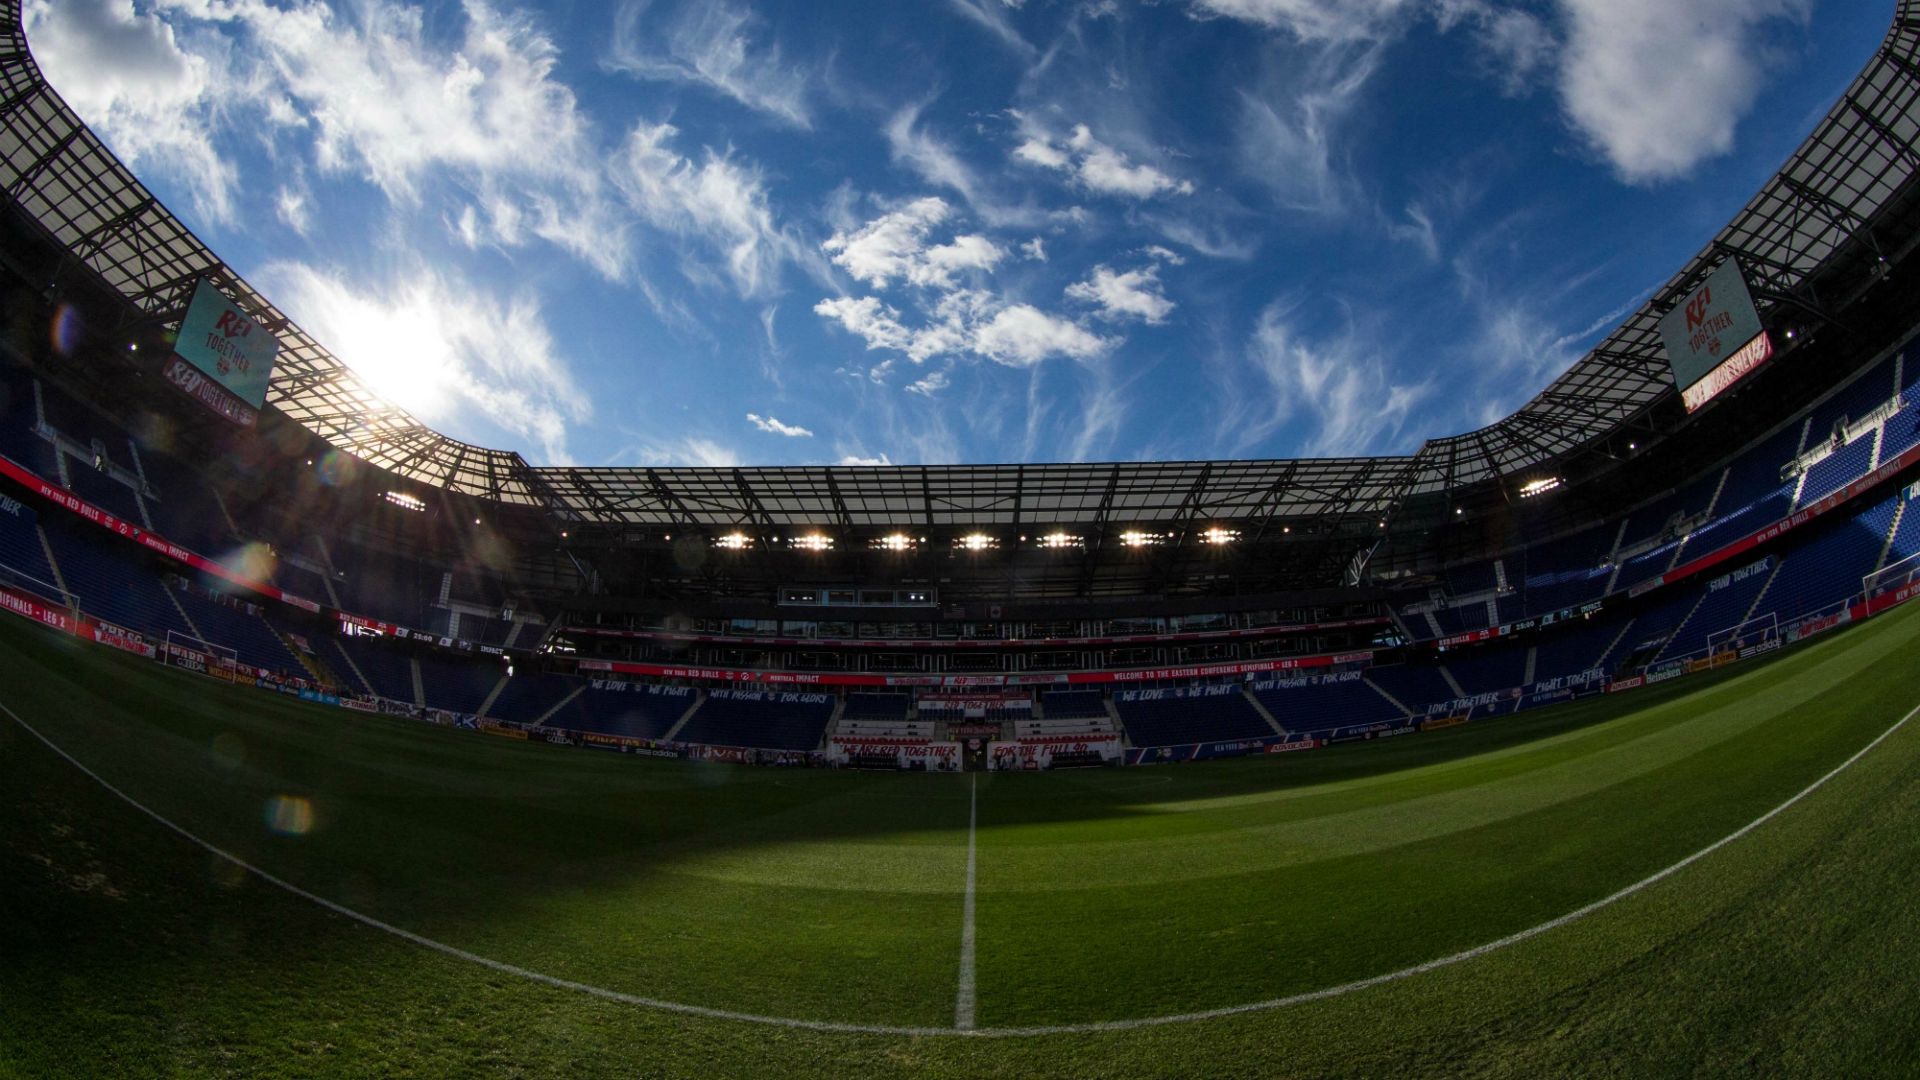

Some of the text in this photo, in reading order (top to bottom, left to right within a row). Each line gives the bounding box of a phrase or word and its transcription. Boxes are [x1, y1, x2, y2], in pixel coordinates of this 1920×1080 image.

[1689, 311, 1734, 355] TOGETHER
[206, 332, 249, 374] TOGETHER
[199, 381, 241, 419] TOGETHER
[66, 497, 79, 511] RED
[81, 503, 99, 520] BULLS
[1780, 519, 1791, 532] RED
[1792, 510, 1809, 527] BULLS
[169, 545, 189, 562] IMPACT
[43, 609, 57, 624] LEG
[60, 616, 65, 628] 2
[688, 669, 699, 677] RED
[702, 670, 719, 678] BULLS
[1114, 671, 1143, 680] WELCOME
[1146, 670, 1154, 679] TO
[1157, 670, 1168, 678] THE
[1171, 667, 1198, 677] EASTERN
[1200, 664, 1238, 675] CONFERENCE
[1240, 661, 1274, 672] SEMIFINALS
[1282, 660, 1292, 669] LEG
[1566, 667, 1604, 686] TOGETHER
[1647, 668, 1680, 684] Heineken
[591, 679, 628, 692] WE LOVE
[796, 675, 819, 683] IMPACT
[1122, 688, 1165, 701] WE LOVE
[1188, 686, 1202, 697] WE
[1427, 692, 1499, 714] LOVE TOGETHER
[653, 749, 678, 758] adidas
[904, 746, 957, 757] TOGETHER
[1020, 745, 1038, 757] THE
